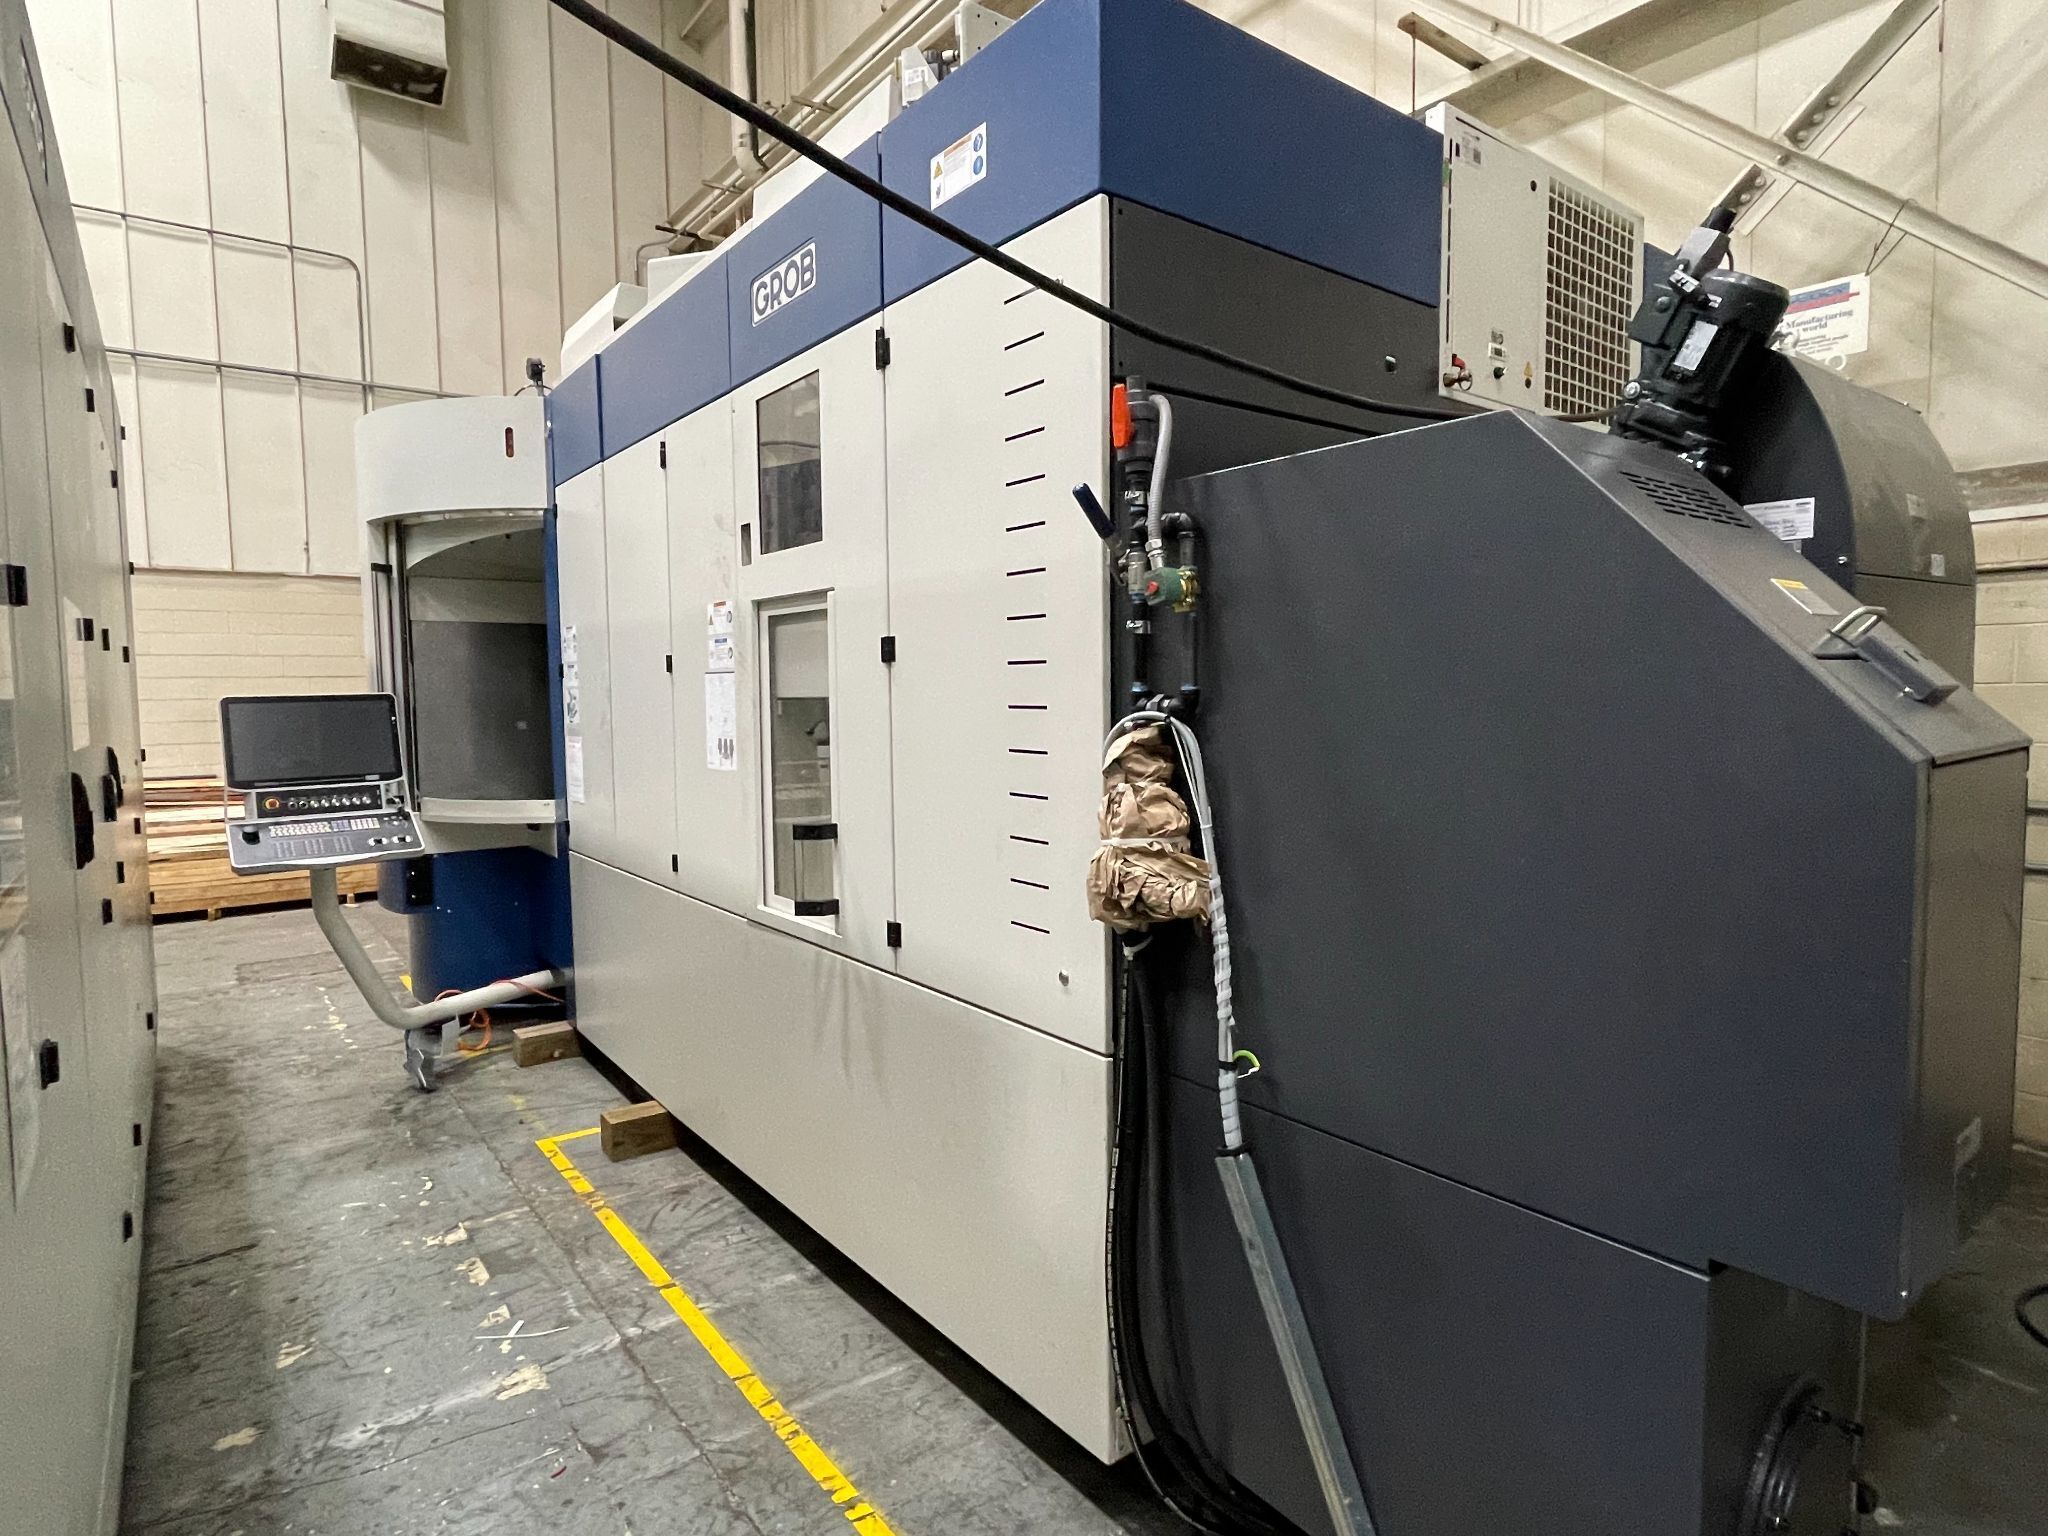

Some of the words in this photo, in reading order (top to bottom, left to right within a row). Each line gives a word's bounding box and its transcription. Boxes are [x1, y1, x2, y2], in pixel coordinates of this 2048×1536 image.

[755, 248, 814, 316] GROB
[1786, 309, 1853, 328] Manufacturing
[1802, 321, 1827, 332] world
